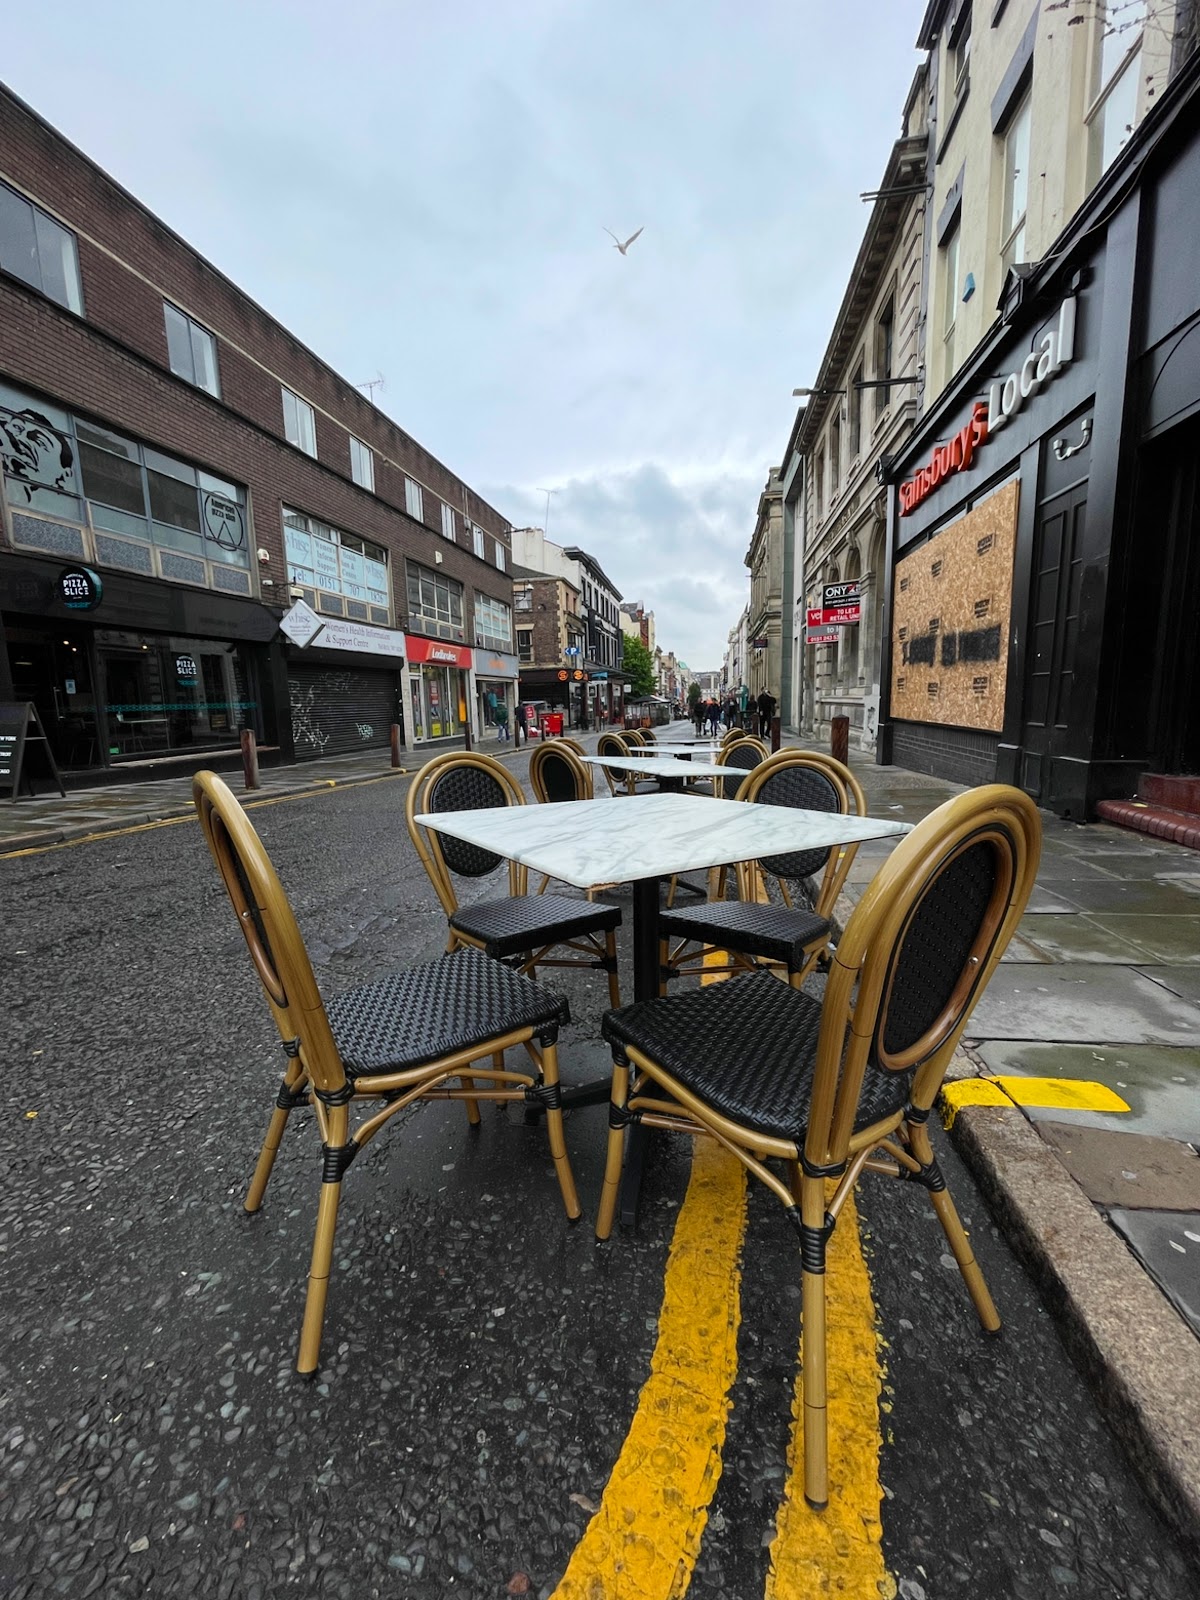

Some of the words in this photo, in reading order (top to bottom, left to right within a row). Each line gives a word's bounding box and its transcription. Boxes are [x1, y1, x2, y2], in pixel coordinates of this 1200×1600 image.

[898, 402, 988, 517] Sainsbury's
[988, 296, 1076, 432] Local
[63, 579, 88, 587] PIZZA
[320, 576, 336, 590] 0151
[64, 587, 89, 596] SLICE
[325, 621, 349, 633] Women's
[349, 625, 365, 637] Health
[325, 633, 331, 642] &
[332, 634, 353, 647] Support
[353, 637, 369, 648] Centre
[176, 660, 196, 668] PIZZA
